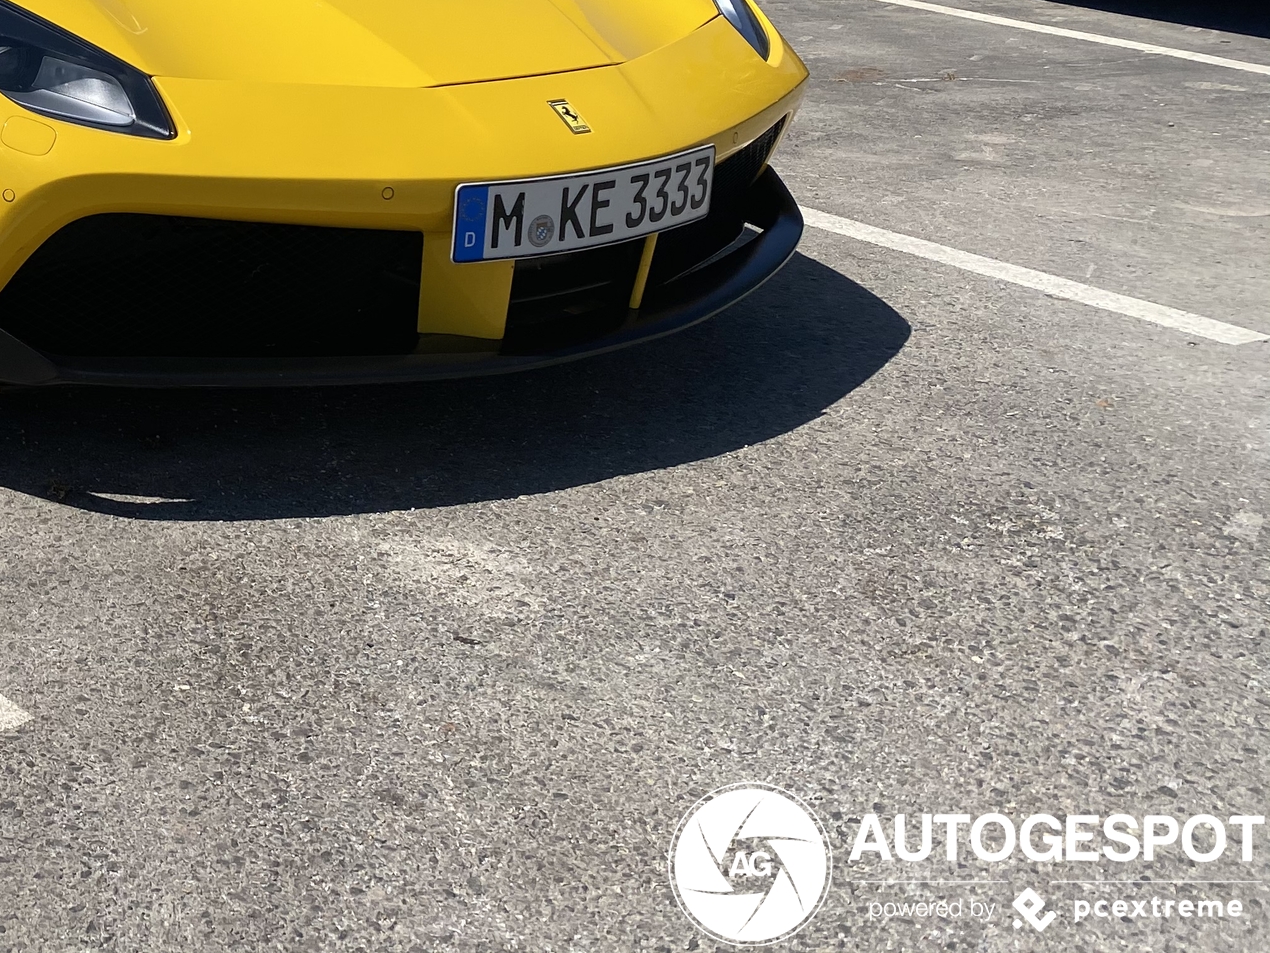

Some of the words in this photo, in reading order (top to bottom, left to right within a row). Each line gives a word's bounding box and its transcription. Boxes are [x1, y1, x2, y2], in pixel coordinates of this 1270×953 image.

[490, 192, 526, 249] M
[559, 179, 616, 242] KE
[625, 155, 711, 229] 3333
[464, 231, 476, 248] D
